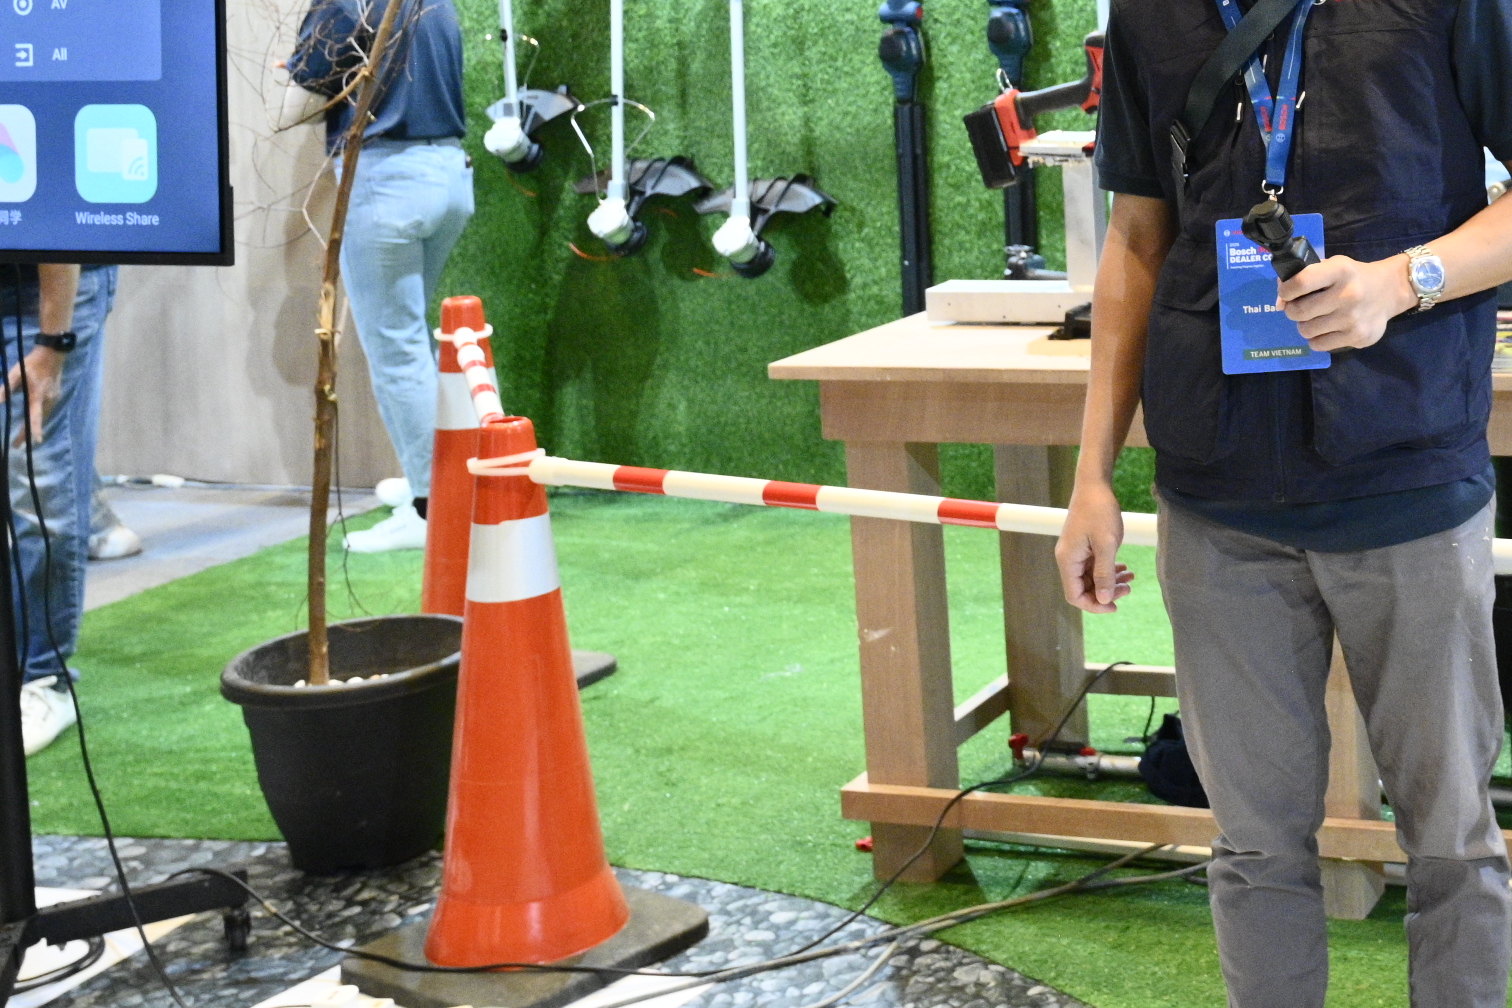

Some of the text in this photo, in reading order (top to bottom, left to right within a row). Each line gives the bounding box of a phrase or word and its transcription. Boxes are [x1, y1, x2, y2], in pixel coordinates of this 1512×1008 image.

[52, 48, 67, 61] All
[75, 211, 160, 225] Wireless Share
[1229, 246, 1257, 256] Bosch
[1229, 254, 1261, 264] DEALER
[1243, 304, 1262, 314] Thai
[1250, 348, 1302, 358] TEAM VIETNAM
